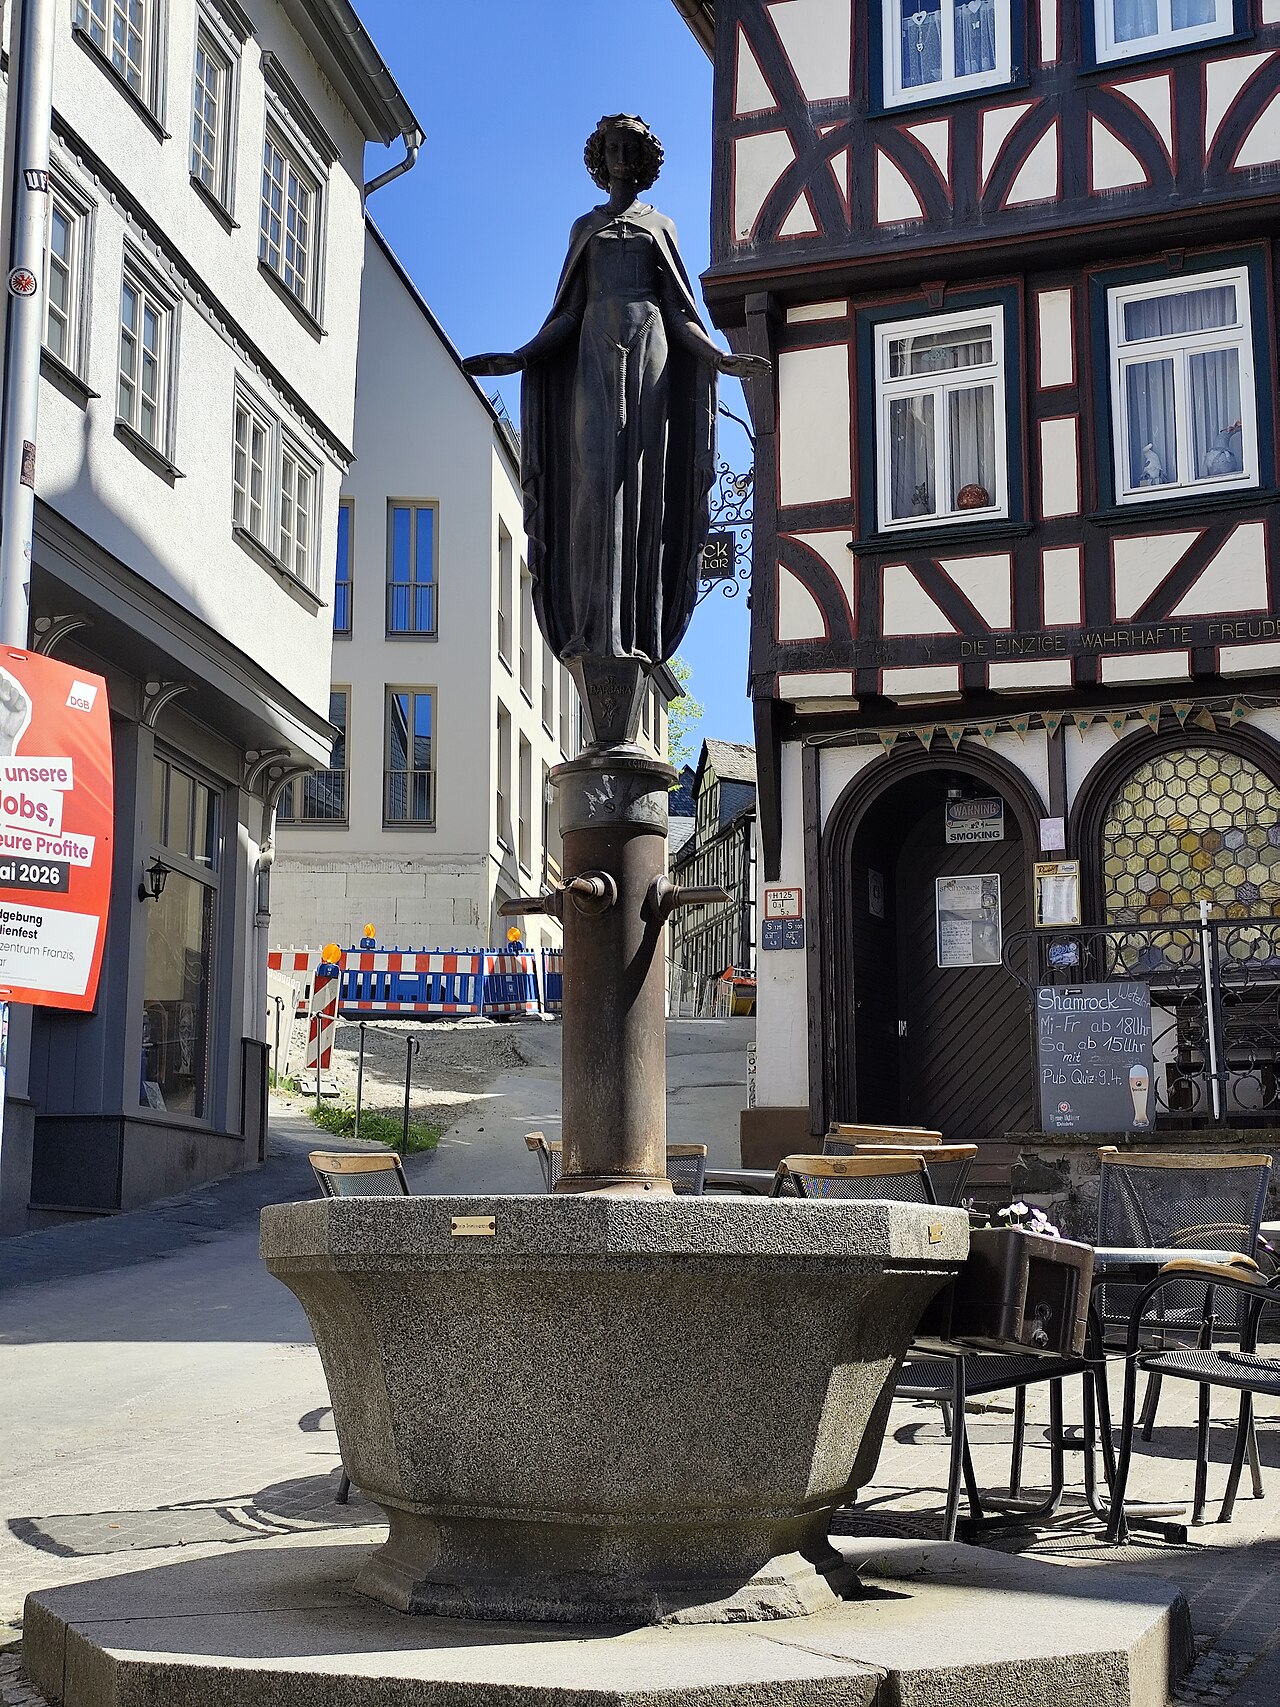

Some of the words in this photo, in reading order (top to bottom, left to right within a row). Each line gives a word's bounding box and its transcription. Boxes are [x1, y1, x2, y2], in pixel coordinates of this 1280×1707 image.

[961, 640, 988, 657] DIE
[1080, 626, 1193, 649] WAHRHAFTE
[70, 695, 90, 710] DGB
[4, 767, 68, 783] unsere
[0, 789, 55, 827] obs,
[953, 804, 997, 817] WARNING
[950, 830, 1000, 841] SMOKING
[36, 837, 89, 860] Profite
[19, 863, 60, 885] 2026
[42, 946, 76, 963] Franzis,
[1038, 987, 1120, 1011] Shamrock
[1040, 1014, 1081, 1035] Mi-Fr
[1090, 1018, 1112, 1033] ab
[1040, 1036, 1067, 1053] Sa
[1078, 1035, 1097, 1051] ab
[1062, 1051, 1081, 1063] mit
[1041, 1068, 1067, 1085] Pub
